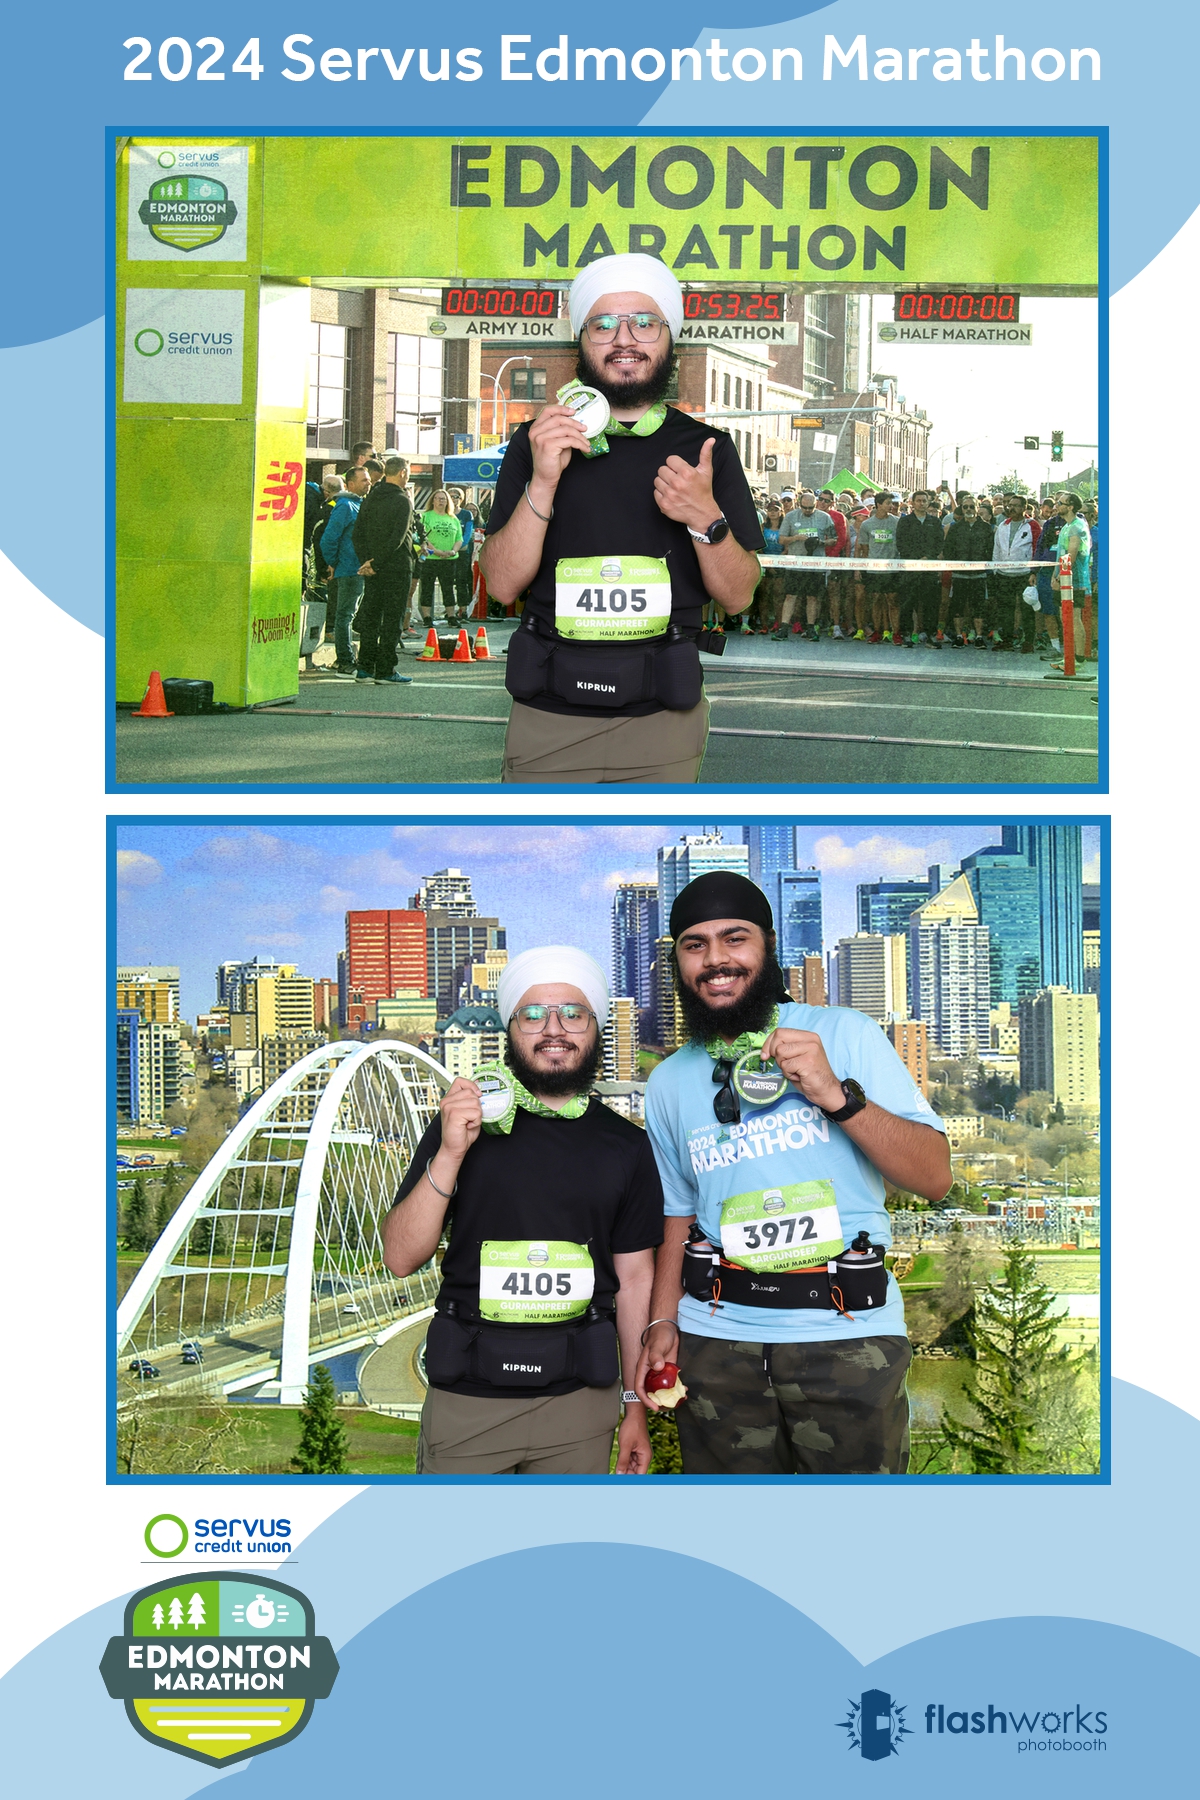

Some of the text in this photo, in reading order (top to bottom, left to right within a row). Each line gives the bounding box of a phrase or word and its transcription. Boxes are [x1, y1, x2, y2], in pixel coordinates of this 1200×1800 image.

[450, 145, 990, 211] EDMONTON
[150, 203, 226, 213] EDMONTON
[523, 223, 906, 271] MARATHON
[466, 322, 554, 335] ARMY 10K
[680, 326, 784, 340] MARATHON
[901, 328, 1030, 340] HALF MARATHON
[168, 332, 232, 344] servus
[168, 346, 200, 354] credit
[576, 589, 647, 612] 4105
[575, 619, 648, 628] GURMANPREET
[577, 681, 616, 693] KIPRUN
[743, 1082, 778, 1091] MARATHON
[688, 1106, 826, 1154] 2024 EDMONTON
[690, 1120, 830, 1175] MARATHON
[744, 1216, 818, 1249] 3972
[750, 1246, 817, 1264] SARGUNDEEP
[774, 1262, 789, 1270] HALF
[792, 1255, 830, 1266] MARATHON
[502, 1272, 571, 1296] 4105
[500, 1302, 572, 1310] GURMANPREET
[503, 1363, 541, 1373] KIPRUN
